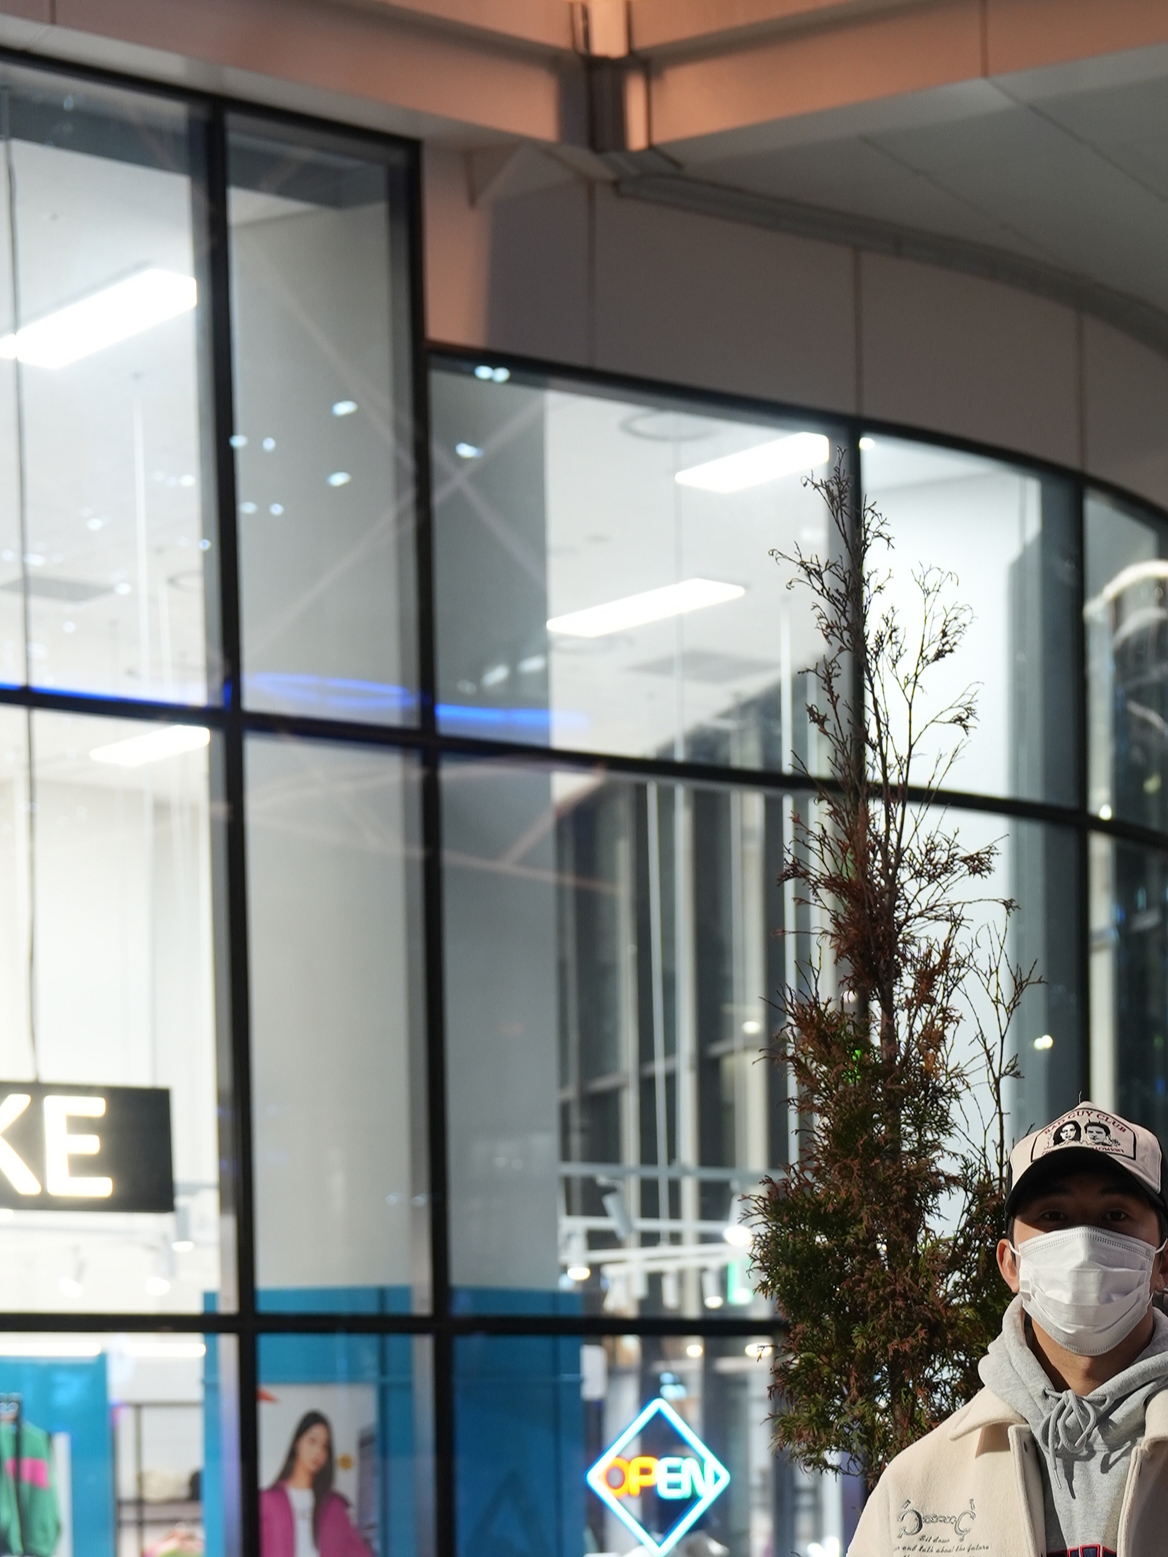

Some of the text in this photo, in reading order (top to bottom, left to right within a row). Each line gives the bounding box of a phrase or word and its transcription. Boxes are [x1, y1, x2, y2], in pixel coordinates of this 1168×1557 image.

[1067, 1110, 1093, 1119] GUY
[1096, 1113, 1127, 1134] CLUB
[597, 1456, 716, 1500] OPEN
